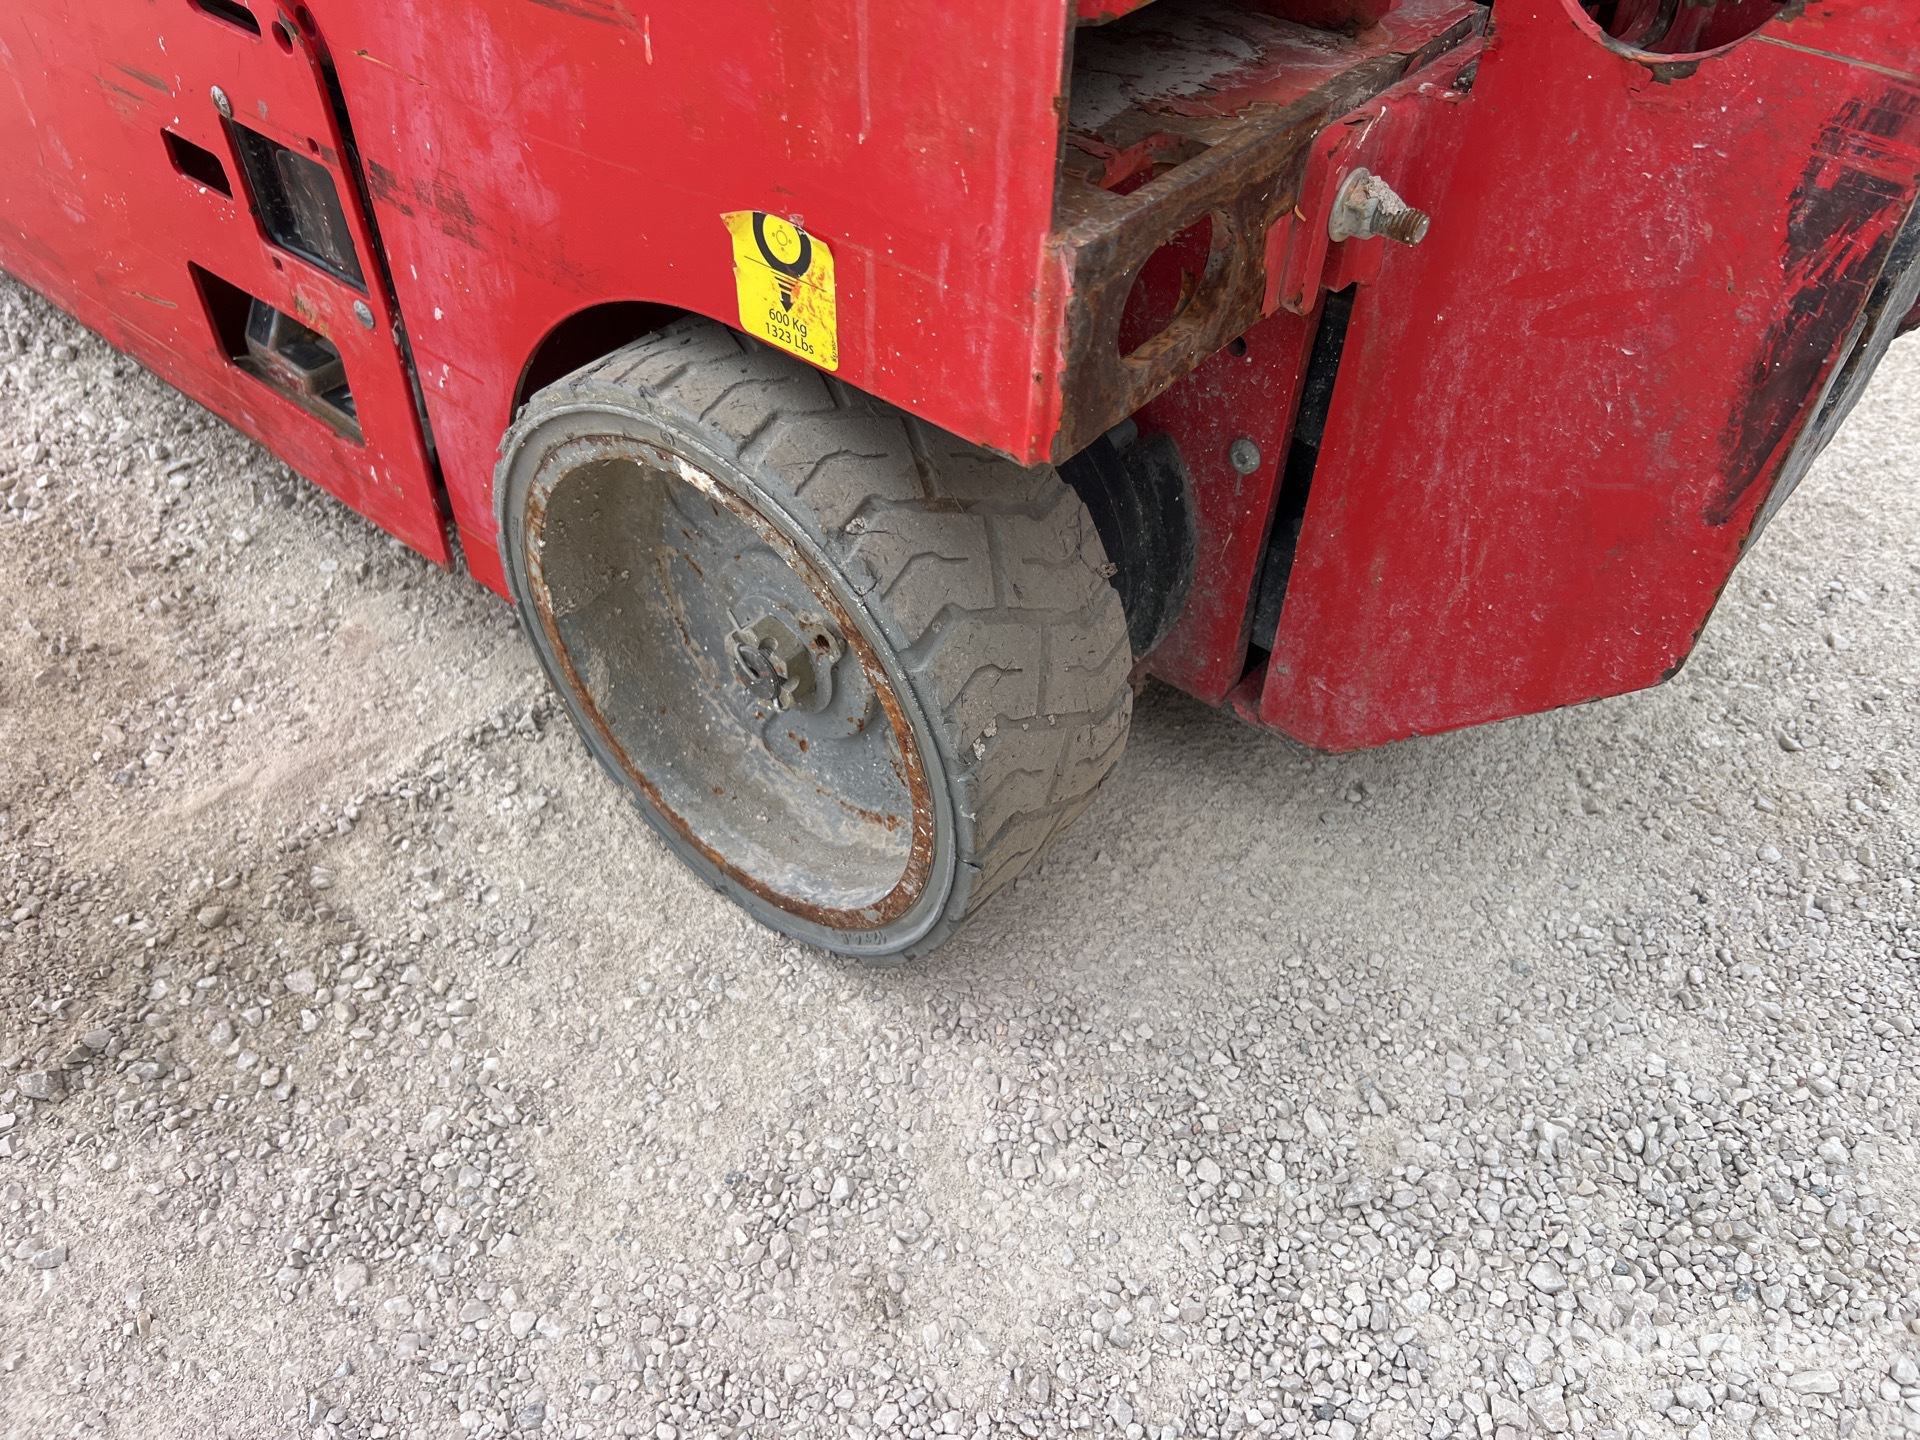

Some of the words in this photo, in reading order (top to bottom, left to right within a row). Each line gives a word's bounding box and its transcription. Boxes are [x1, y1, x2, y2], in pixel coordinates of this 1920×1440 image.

[765, 322, 791, 344] 1323
[794, 334, 814, 355] Lbs
[769, 308, 789, 326] 600
[792, 317, 807, 338] Kg
